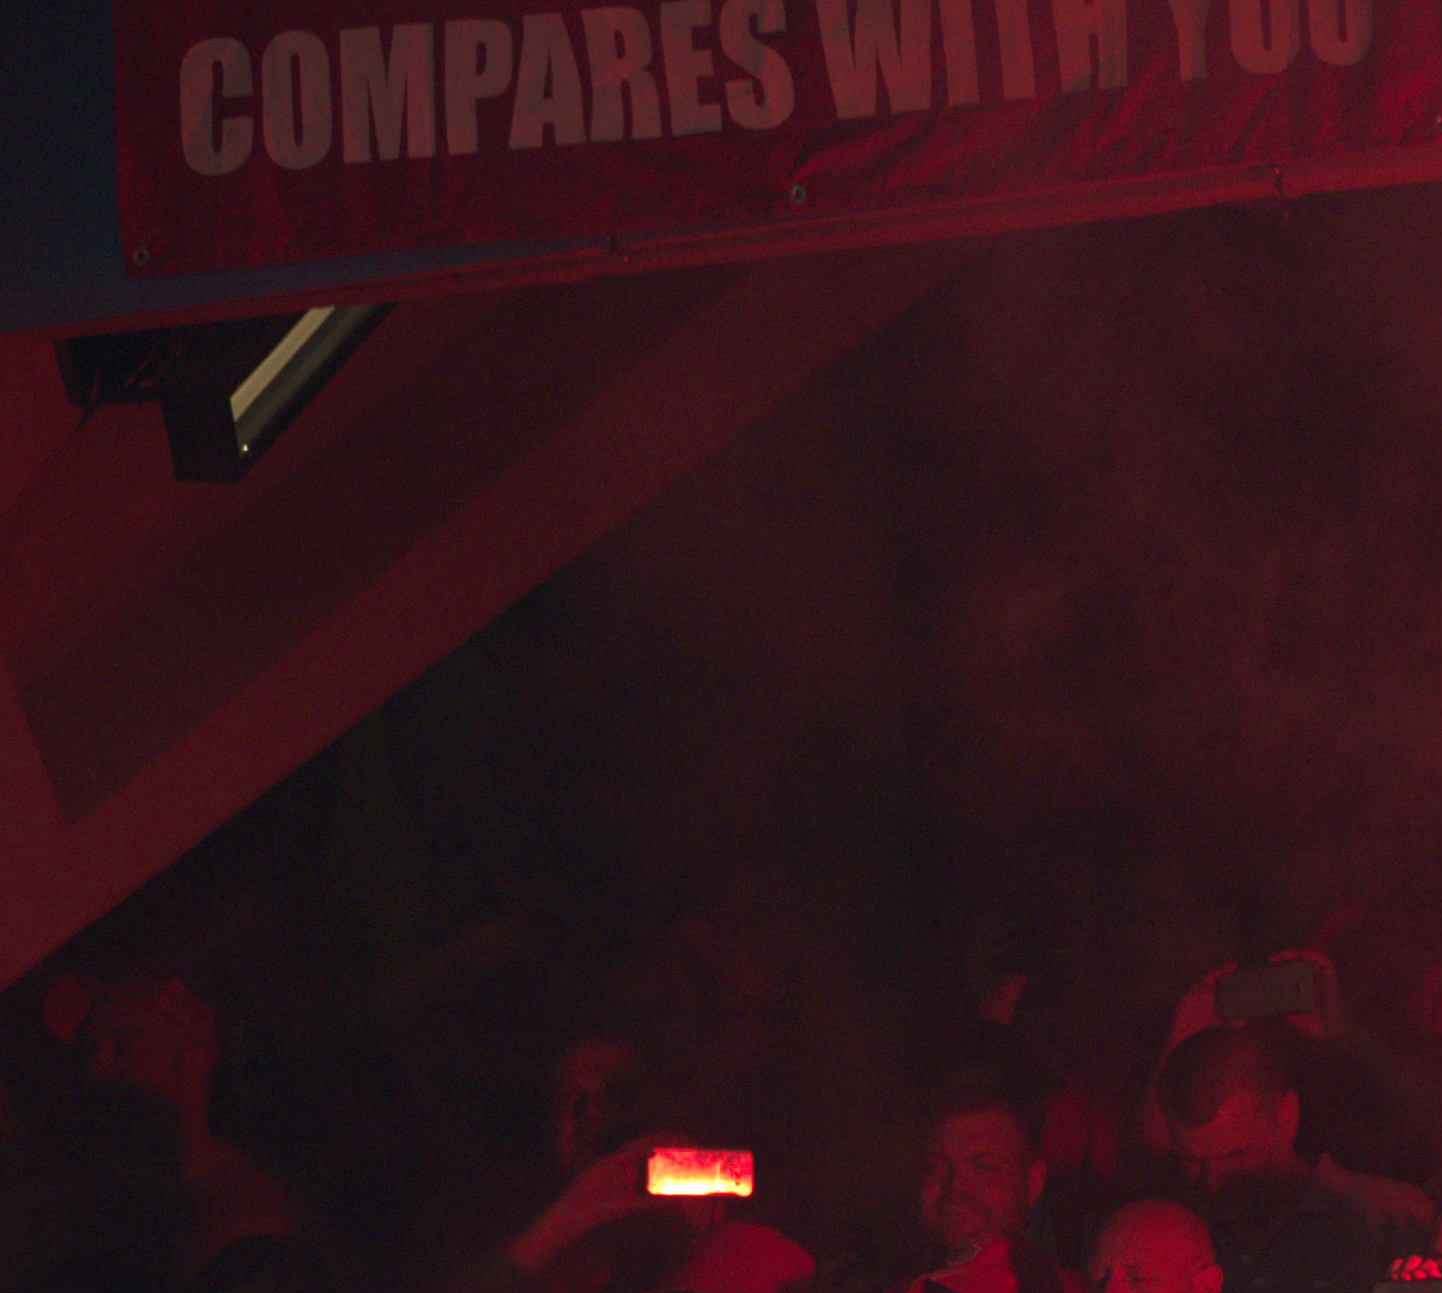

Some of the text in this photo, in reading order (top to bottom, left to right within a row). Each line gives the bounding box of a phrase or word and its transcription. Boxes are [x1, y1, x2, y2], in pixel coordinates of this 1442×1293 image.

[180, 0, 1373, 177] COMPARES WITH YOU
